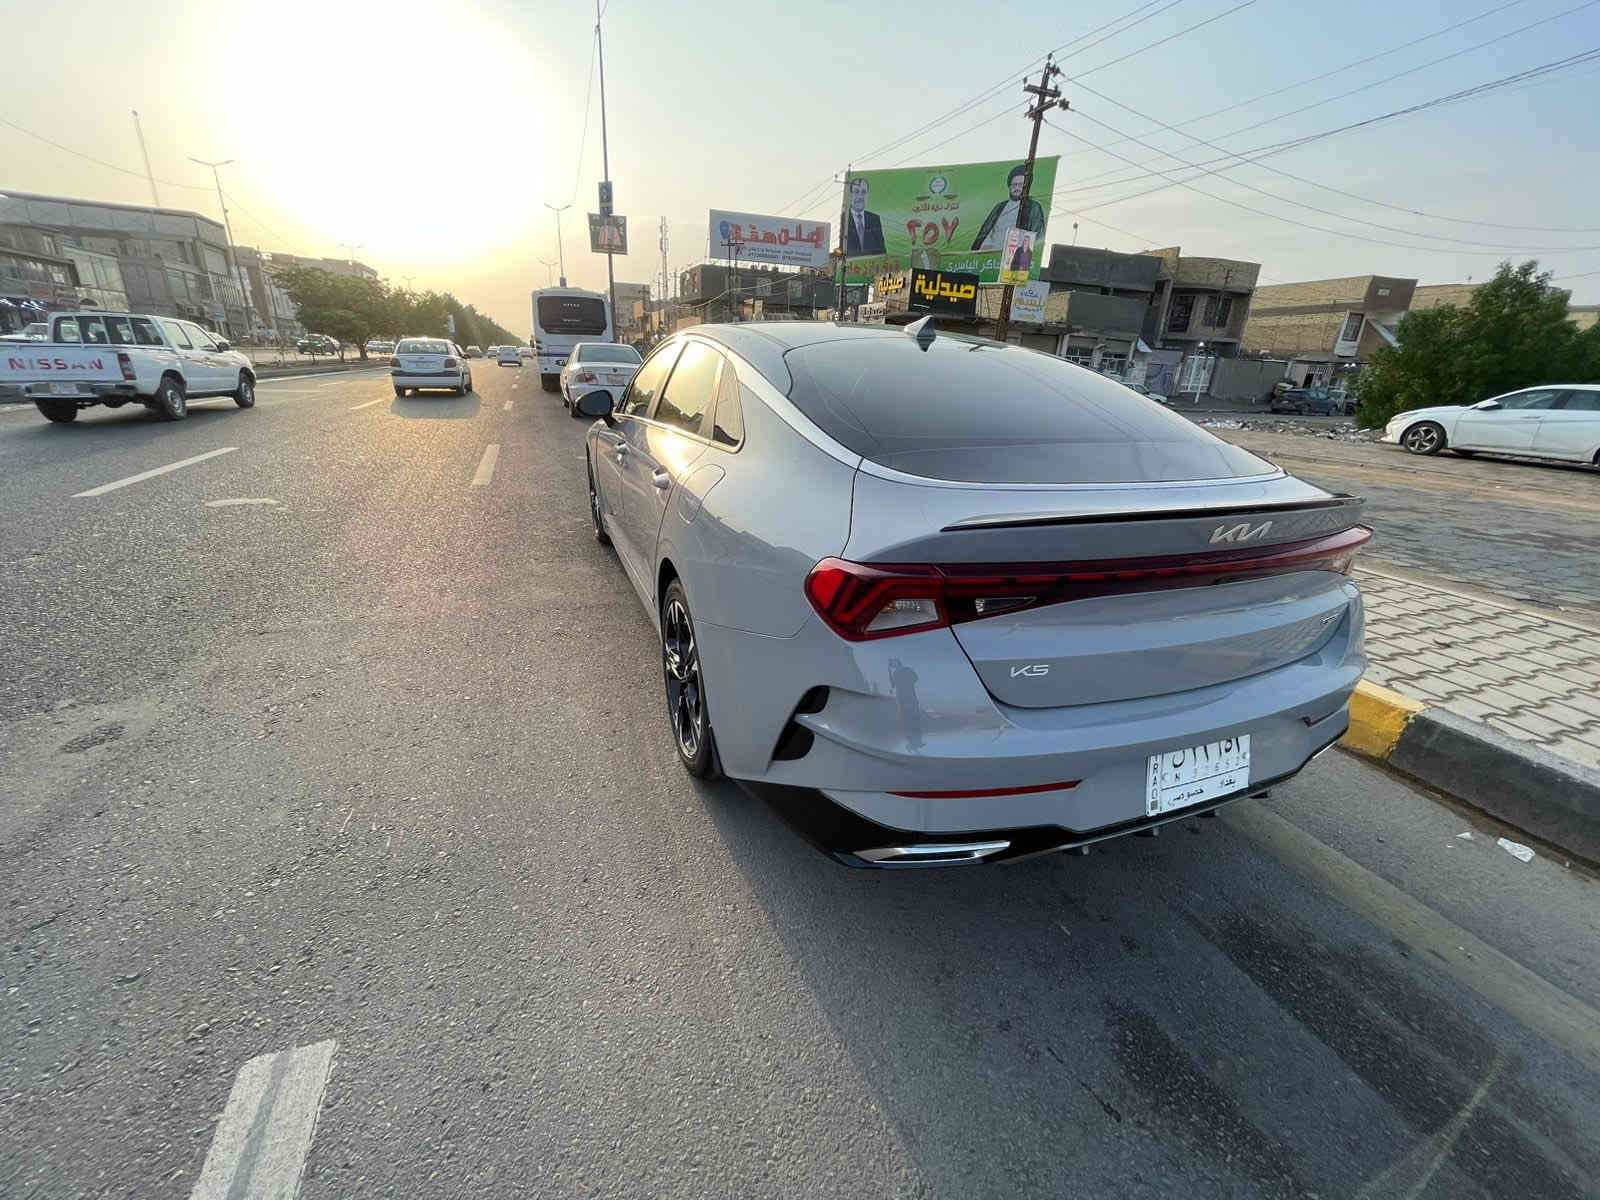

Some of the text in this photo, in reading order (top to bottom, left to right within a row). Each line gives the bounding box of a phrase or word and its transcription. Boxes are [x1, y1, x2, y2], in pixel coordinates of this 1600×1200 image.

[906, 215, 960, 246] ٢٥٧
[914, 273, 977, 303] صيدلية
[8, 358, 105, 370] NISSAN
[1010, 664, 1049, 678] K5
